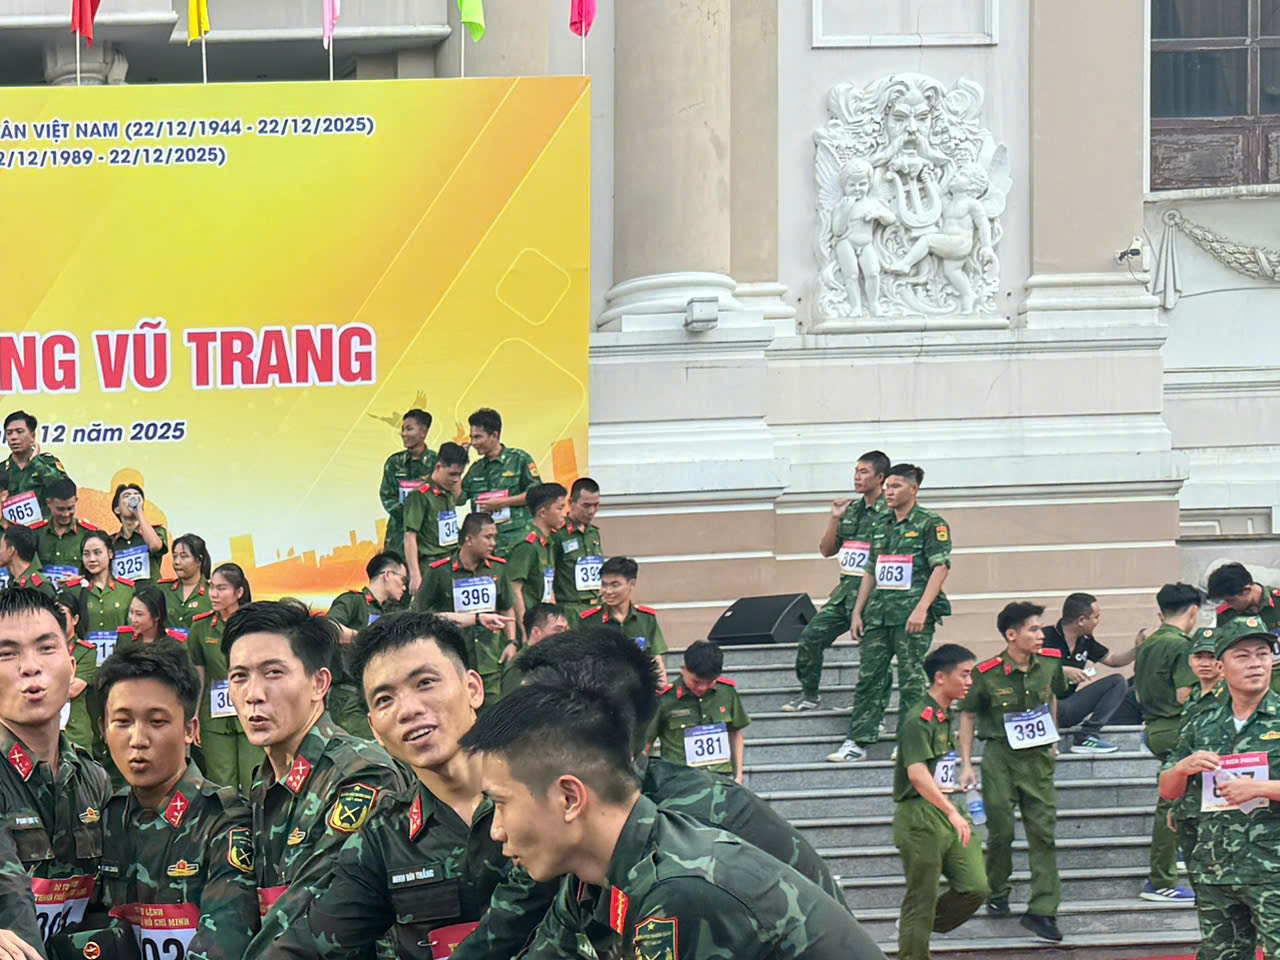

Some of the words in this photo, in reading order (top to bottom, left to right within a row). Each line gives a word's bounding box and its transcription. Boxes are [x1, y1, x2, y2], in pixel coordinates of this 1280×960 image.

[33, 119, 70, 142] VIỆT
[76, 122, 118, 138] NAM
[125, 119, 242, 141] (22/12/1944
[257, 117, 374, 136] 22/12/2025)
[109, 147, 226, 167] 22/12/2025)
[96, 320, 168, 389] VŨ
[186, 326, 373, 388] TRANG
[40, 425, 65, 444] 12
[72, 423, 123, 443] năm
[130, 420, 186, 441] 2025
[8, 502, 34, 521] 865
[116, 555, 143, 576] 325
[878, 565, 904, 582] 863
[461, 587, 490, 606] 396
[1014, 719, 1047, 741] 339
[694, 736, 722, 757] 381
